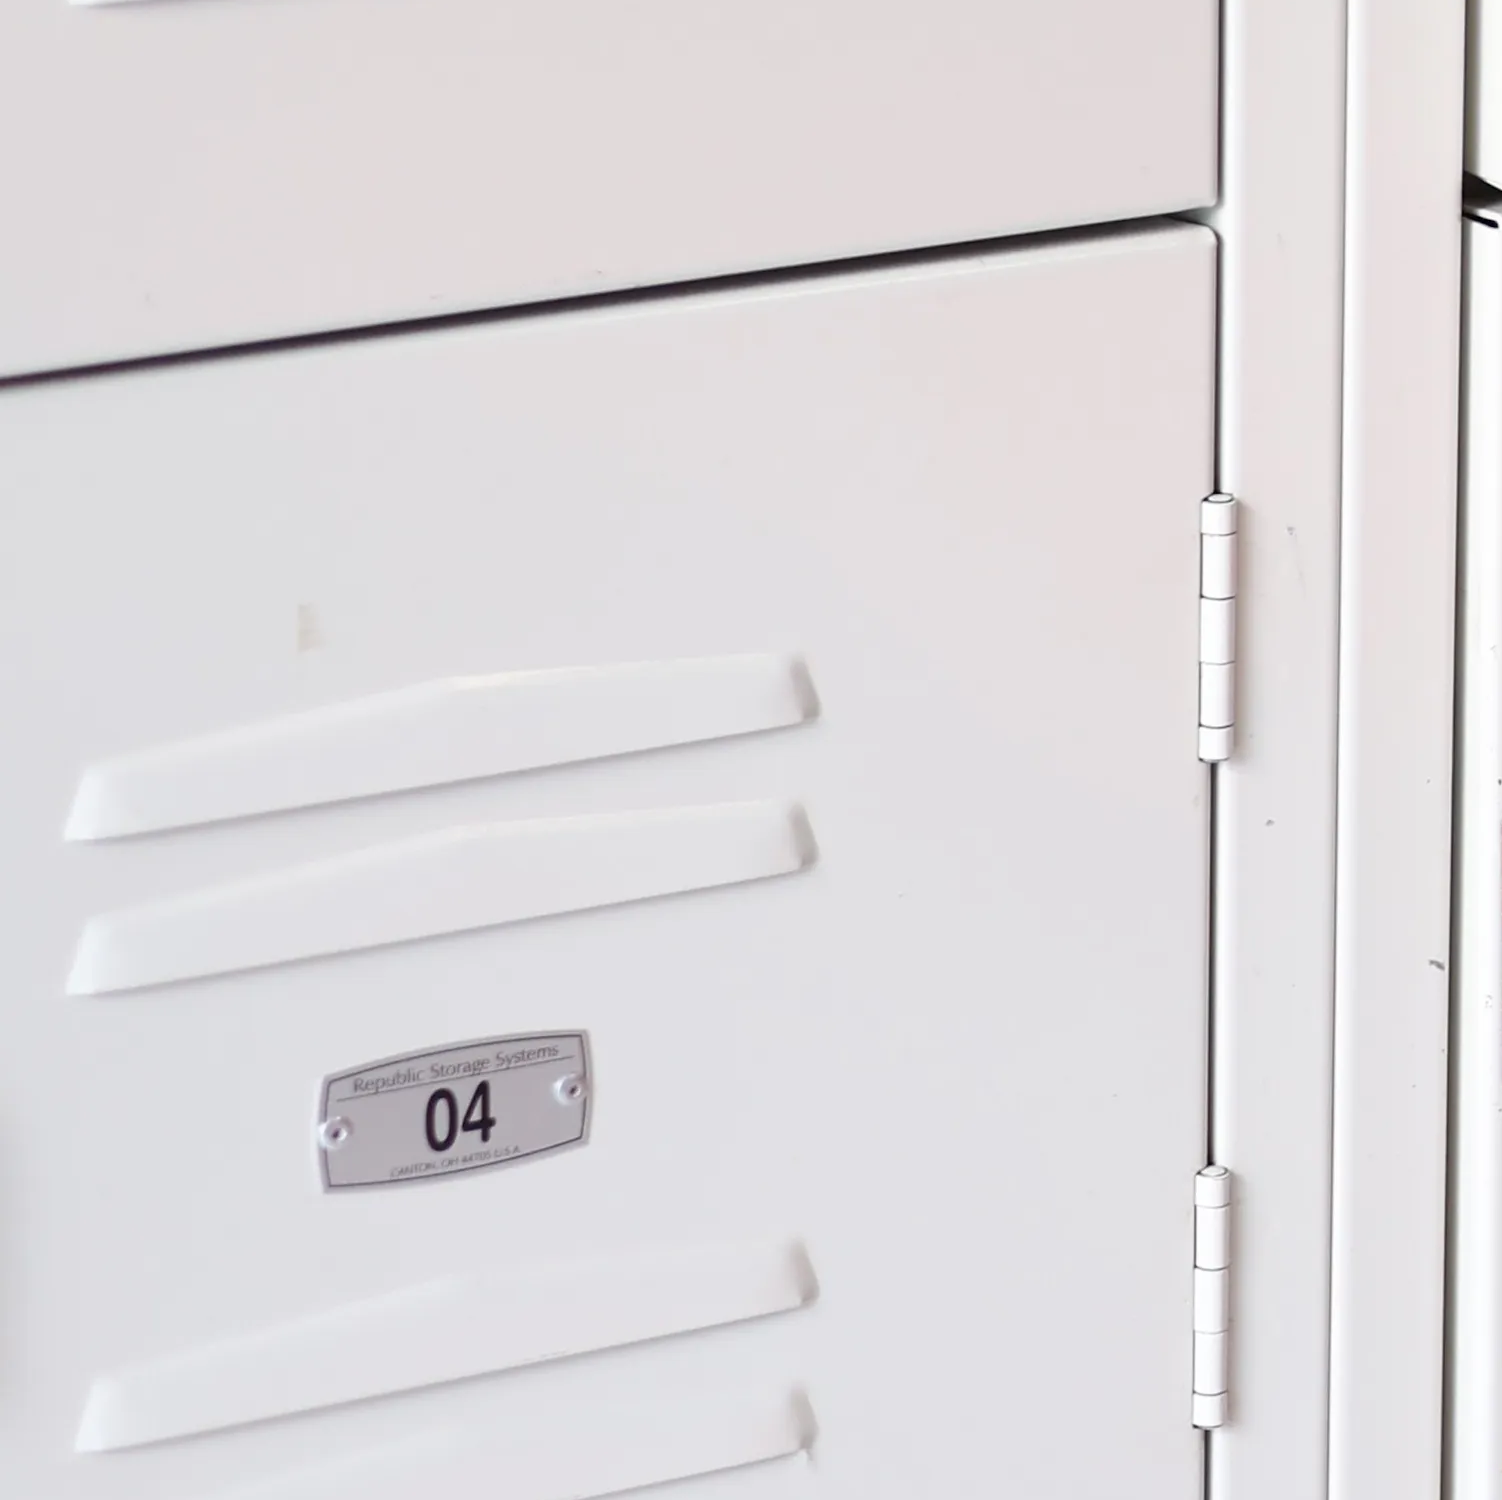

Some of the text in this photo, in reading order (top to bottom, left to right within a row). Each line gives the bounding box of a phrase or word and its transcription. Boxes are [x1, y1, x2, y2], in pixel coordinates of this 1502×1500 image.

[353, 1044, 559, 1093] Republic Storage Systems
[425, 1080, 497, 1152] 04
